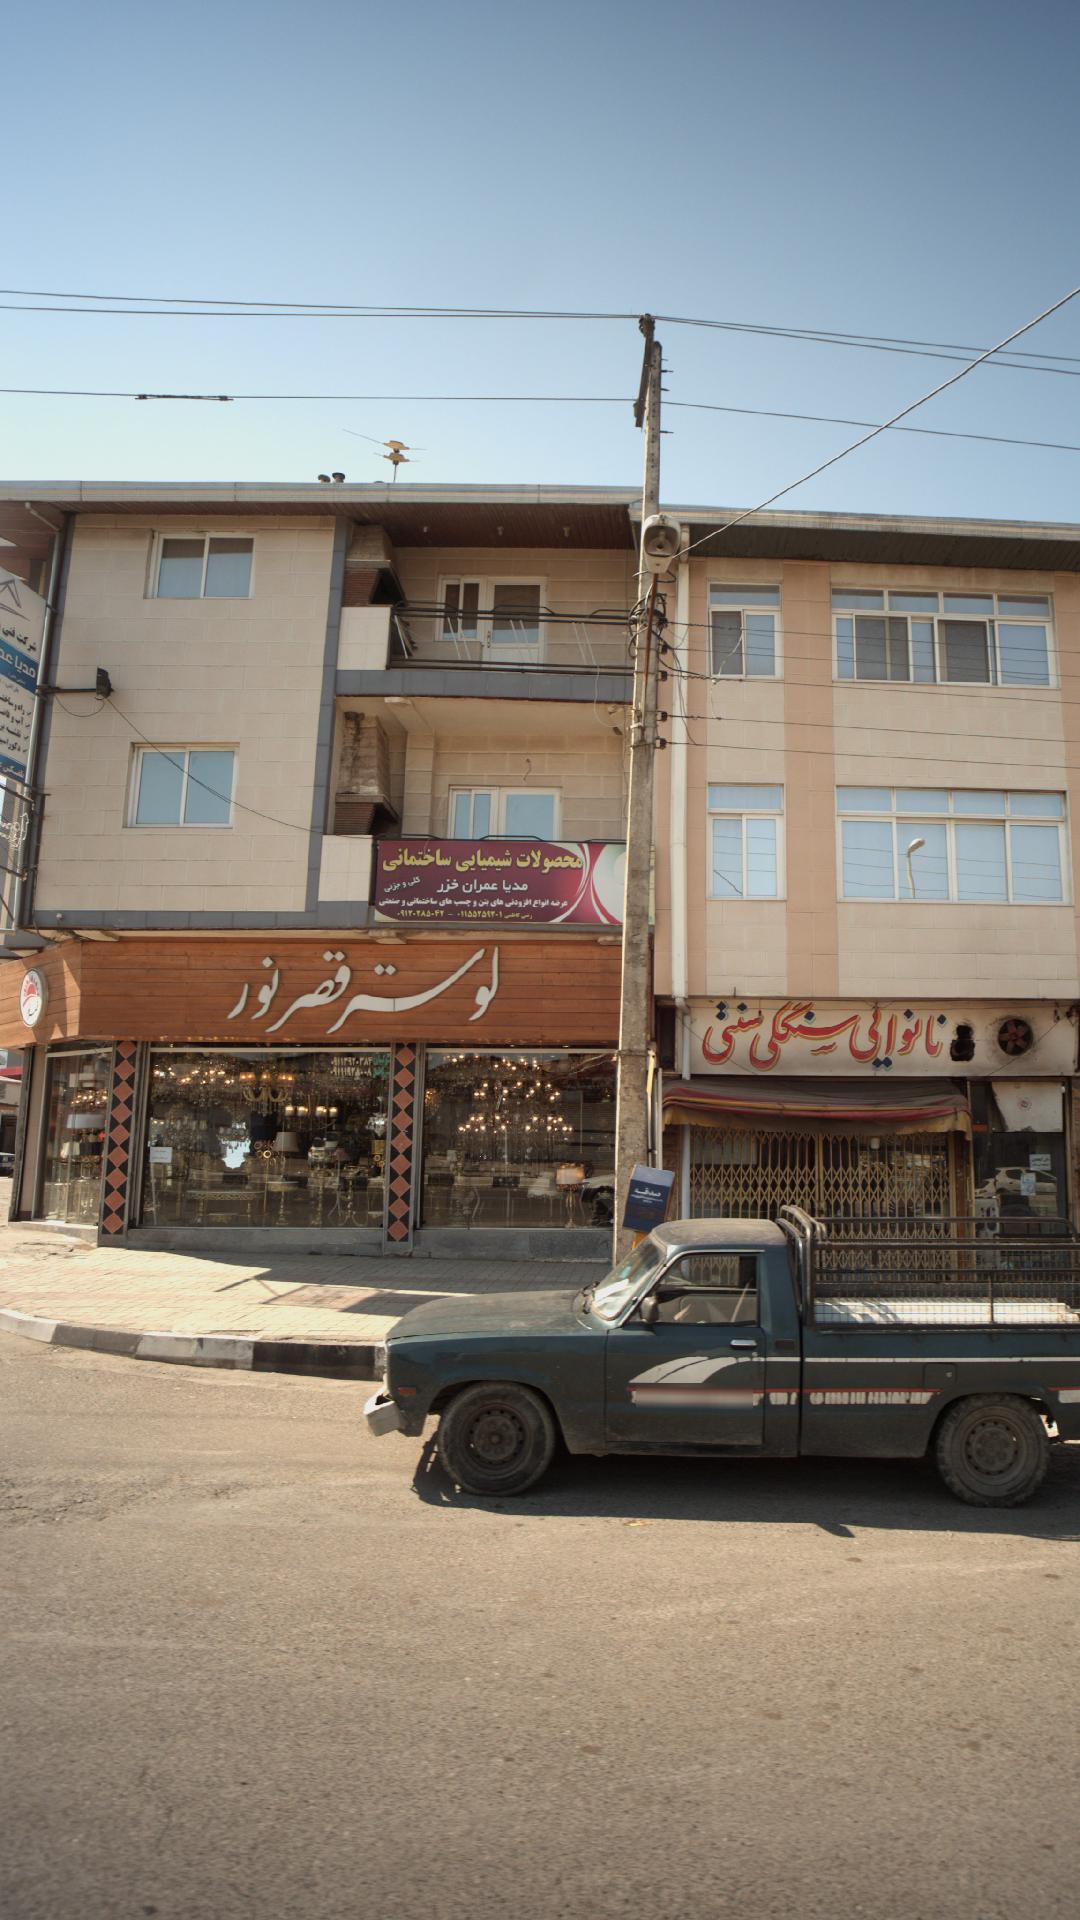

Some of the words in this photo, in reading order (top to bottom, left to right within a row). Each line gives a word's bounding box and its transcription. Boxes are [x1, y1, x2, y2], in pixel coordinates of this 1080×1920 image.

[382, 847, 452, 871] ساختمانی
[455, 848, 512, 872] شیمیایی
[516, 848, 584, 873] محصولات
[402, 880, 407, 888] و
[407, 876, 421, 888] کلی
[436, 878, 460, 893] خزر
[461, 879, 499, 893] عمران
[502, 879, 529, 894] مدیا
[379, 898, 401, 907] صنعتی
[406, 897, 438, 906] ساختمانی
[438, 897, 453, 906] های
[489, 897, 504, 907] های
[505, 898, 532, 908] افزودنی
[532, 899, 550, 908] انواع
[550, 900, 569, 909] عرضه
[226, 956, 279, 1020] نور
[264, 950, 352, 1033] قصر
[326, 945, 500, 1034] لوستر
[702, 1001, 764, 1065] سنتی
[749, 1001, 860, 1071] سنگکی
[849, 1006, 948, 1071] نانوایی
